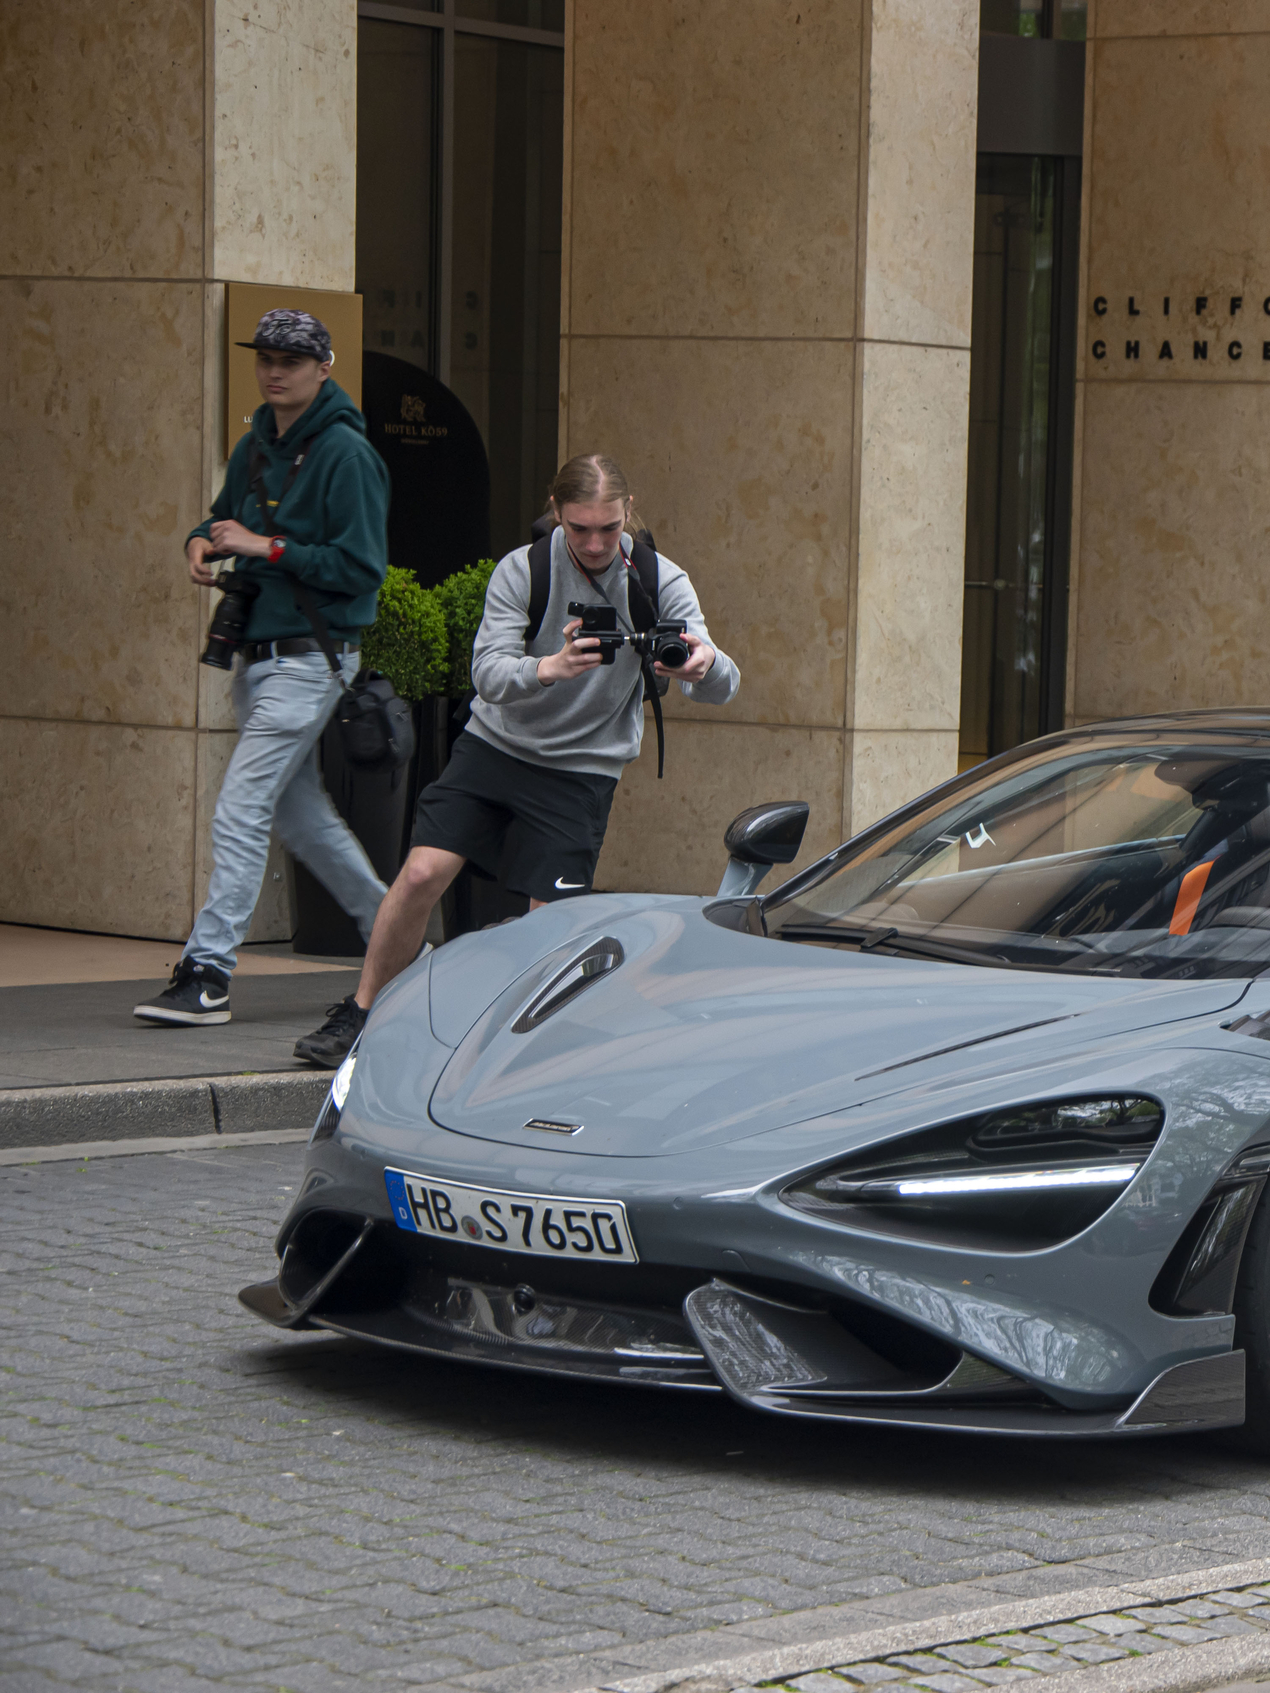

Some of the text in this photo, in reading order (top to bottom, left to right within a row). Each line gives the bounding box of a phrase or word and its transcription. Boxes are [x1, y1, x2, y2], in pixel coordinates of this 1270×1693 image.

[384, 423, 417, 436] HOTEL
[398, 1206, 408, 1220] D
[406, 1182, 458, 1233] HB
